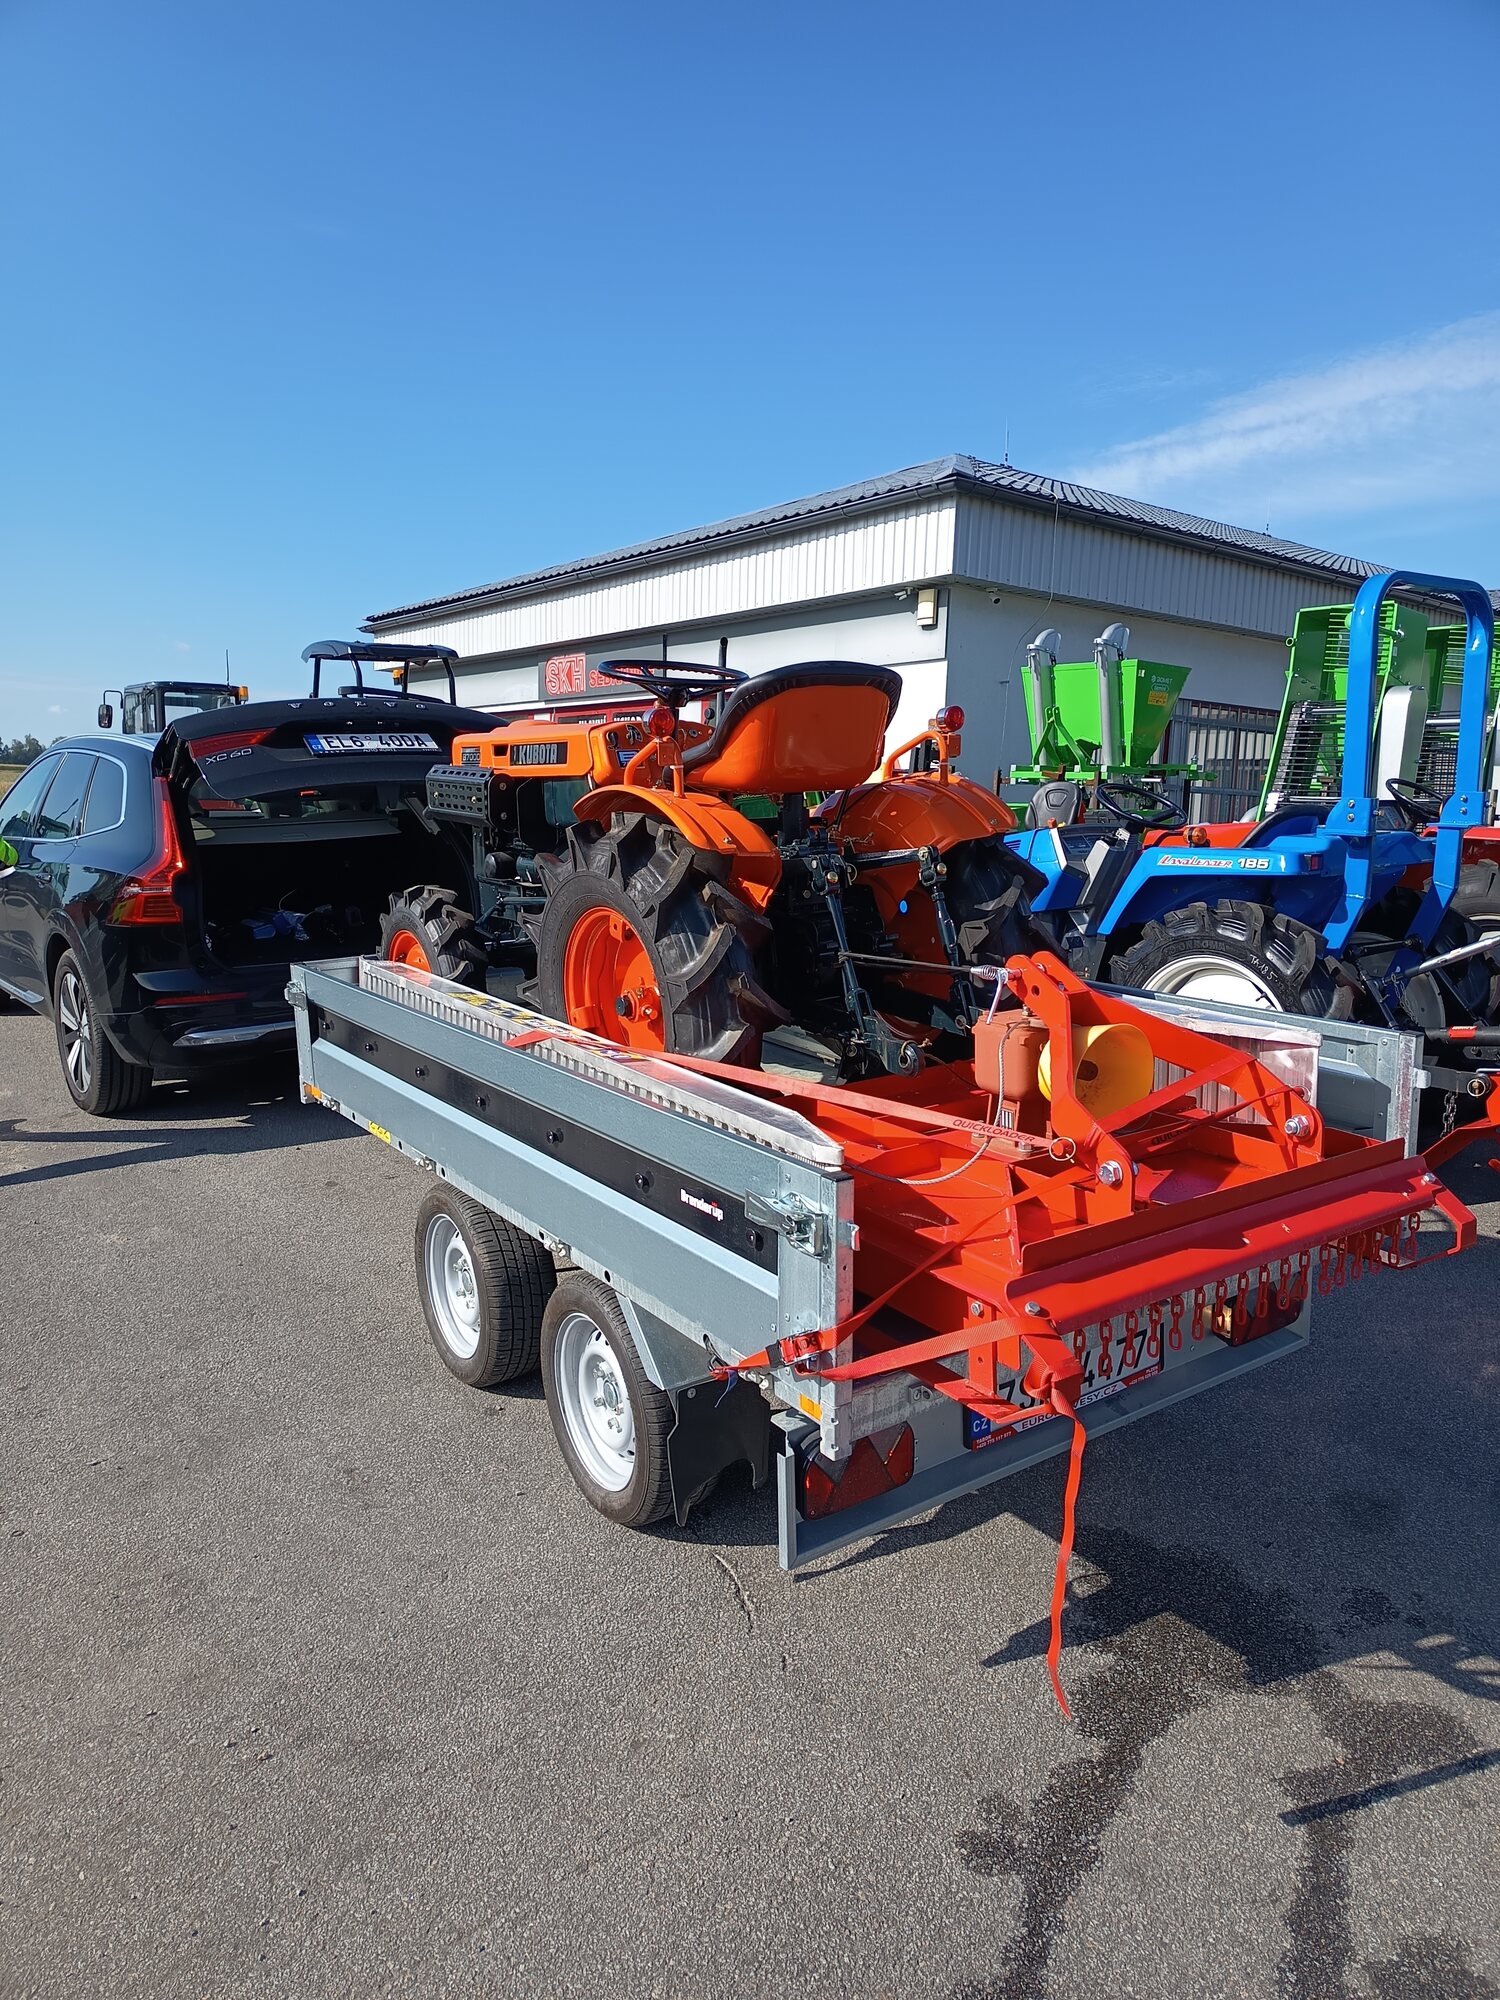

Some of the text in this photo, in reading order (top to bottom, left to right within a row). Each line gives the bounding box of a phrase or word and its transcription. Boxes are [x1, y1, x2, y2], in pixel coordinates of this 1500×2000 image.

[545, 653, 586, 695] SKH
[519, 743, 558, 765] KUBOTA
[1237, 858, 1270, 869] 185
[952, 1118, 1036, 1143] QUICKLOADER
[973, 1417, 988, 1432] CZ
